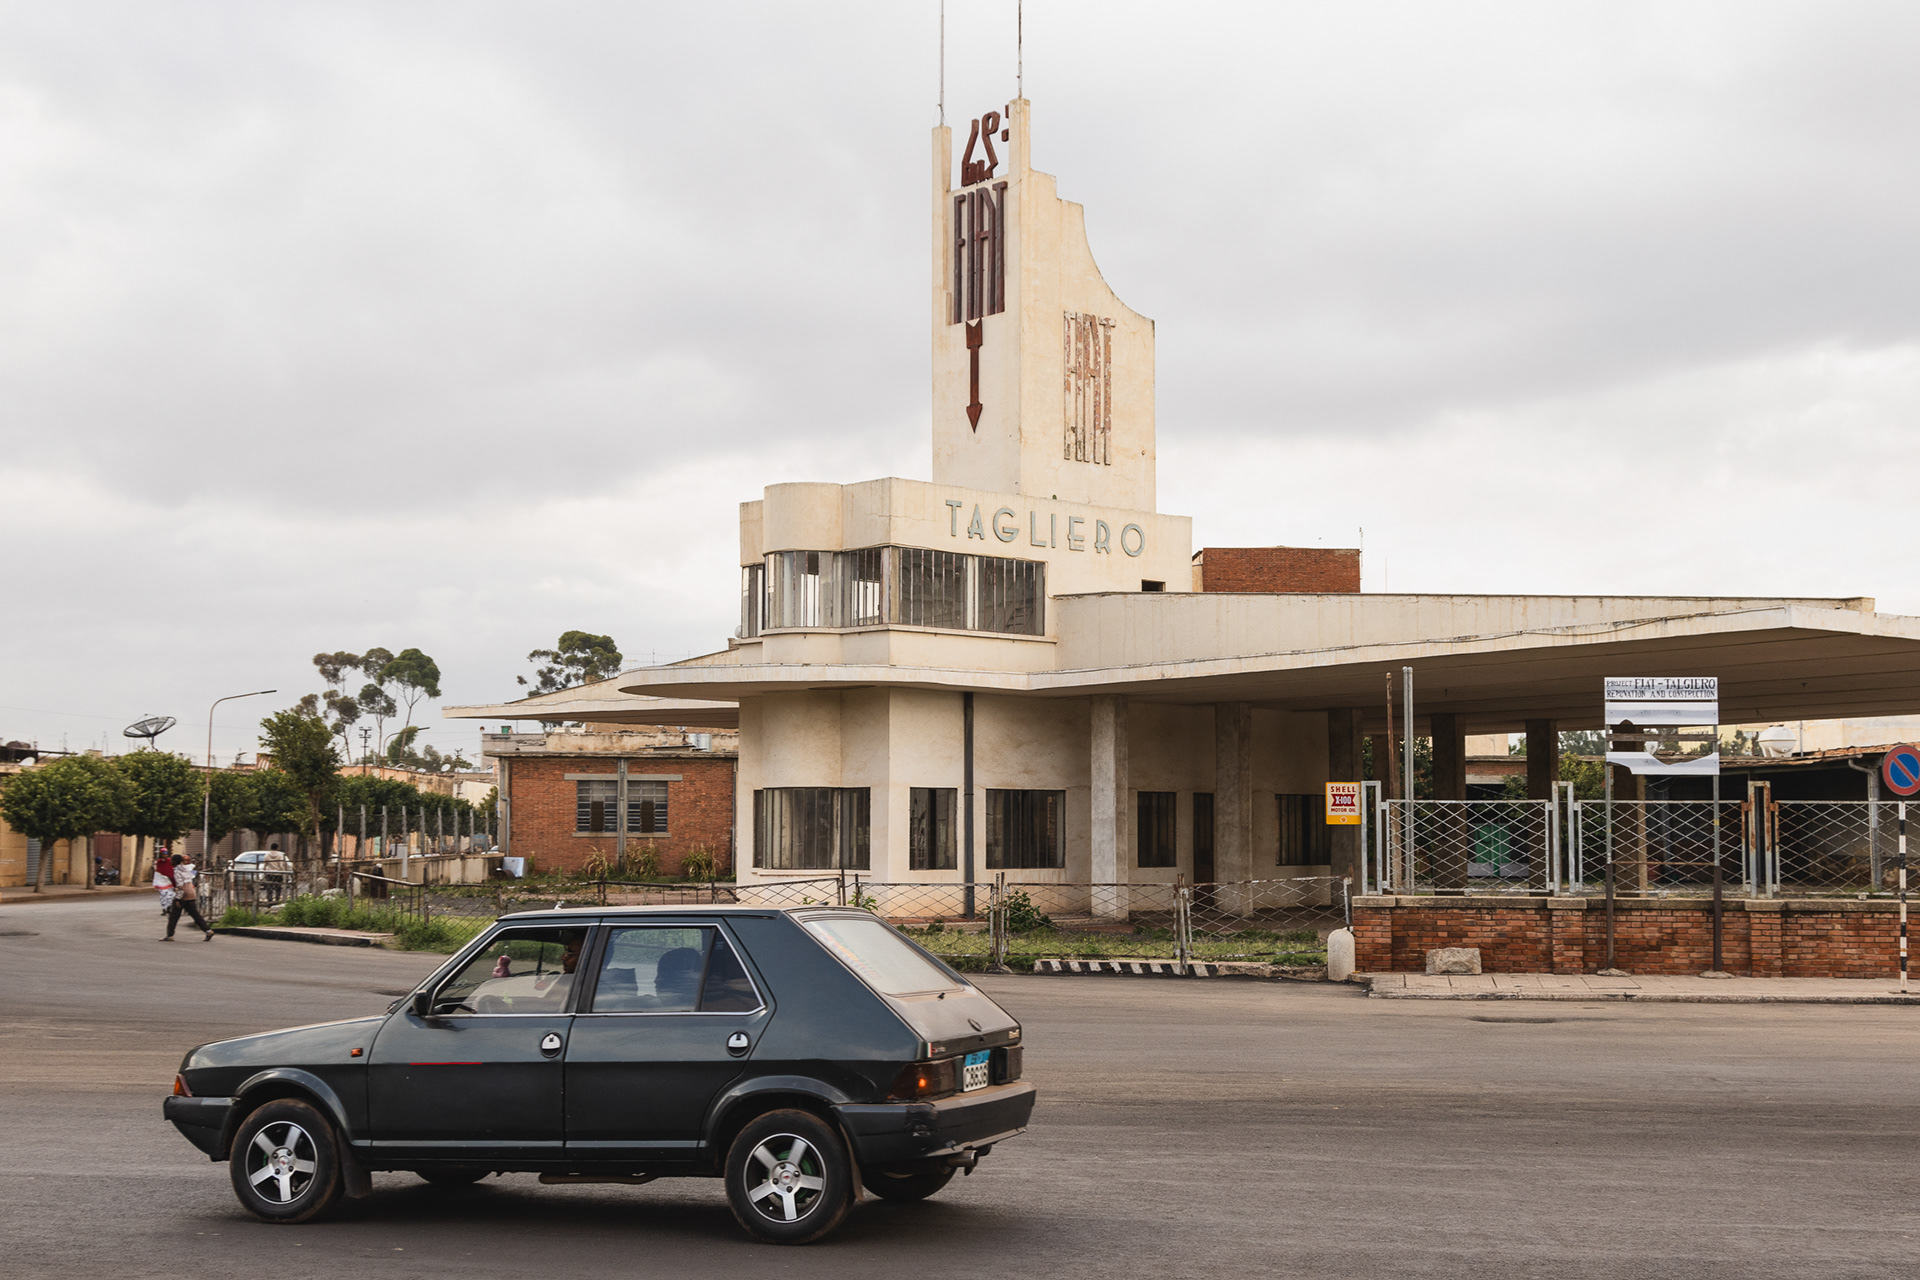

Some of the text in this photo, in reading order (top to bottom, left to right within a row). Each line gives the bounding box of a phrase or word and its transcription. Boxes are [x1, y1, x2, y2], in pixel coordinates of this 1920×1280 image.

[953, 180, 1008, 325] FIAT
[1063, 310, 1117, 466] FIAT
[945, 499, 1146, 558] TAGLIERO
[1649, 690, 1666, 698] AND
[1336, 796, 1352, 804] X-100
